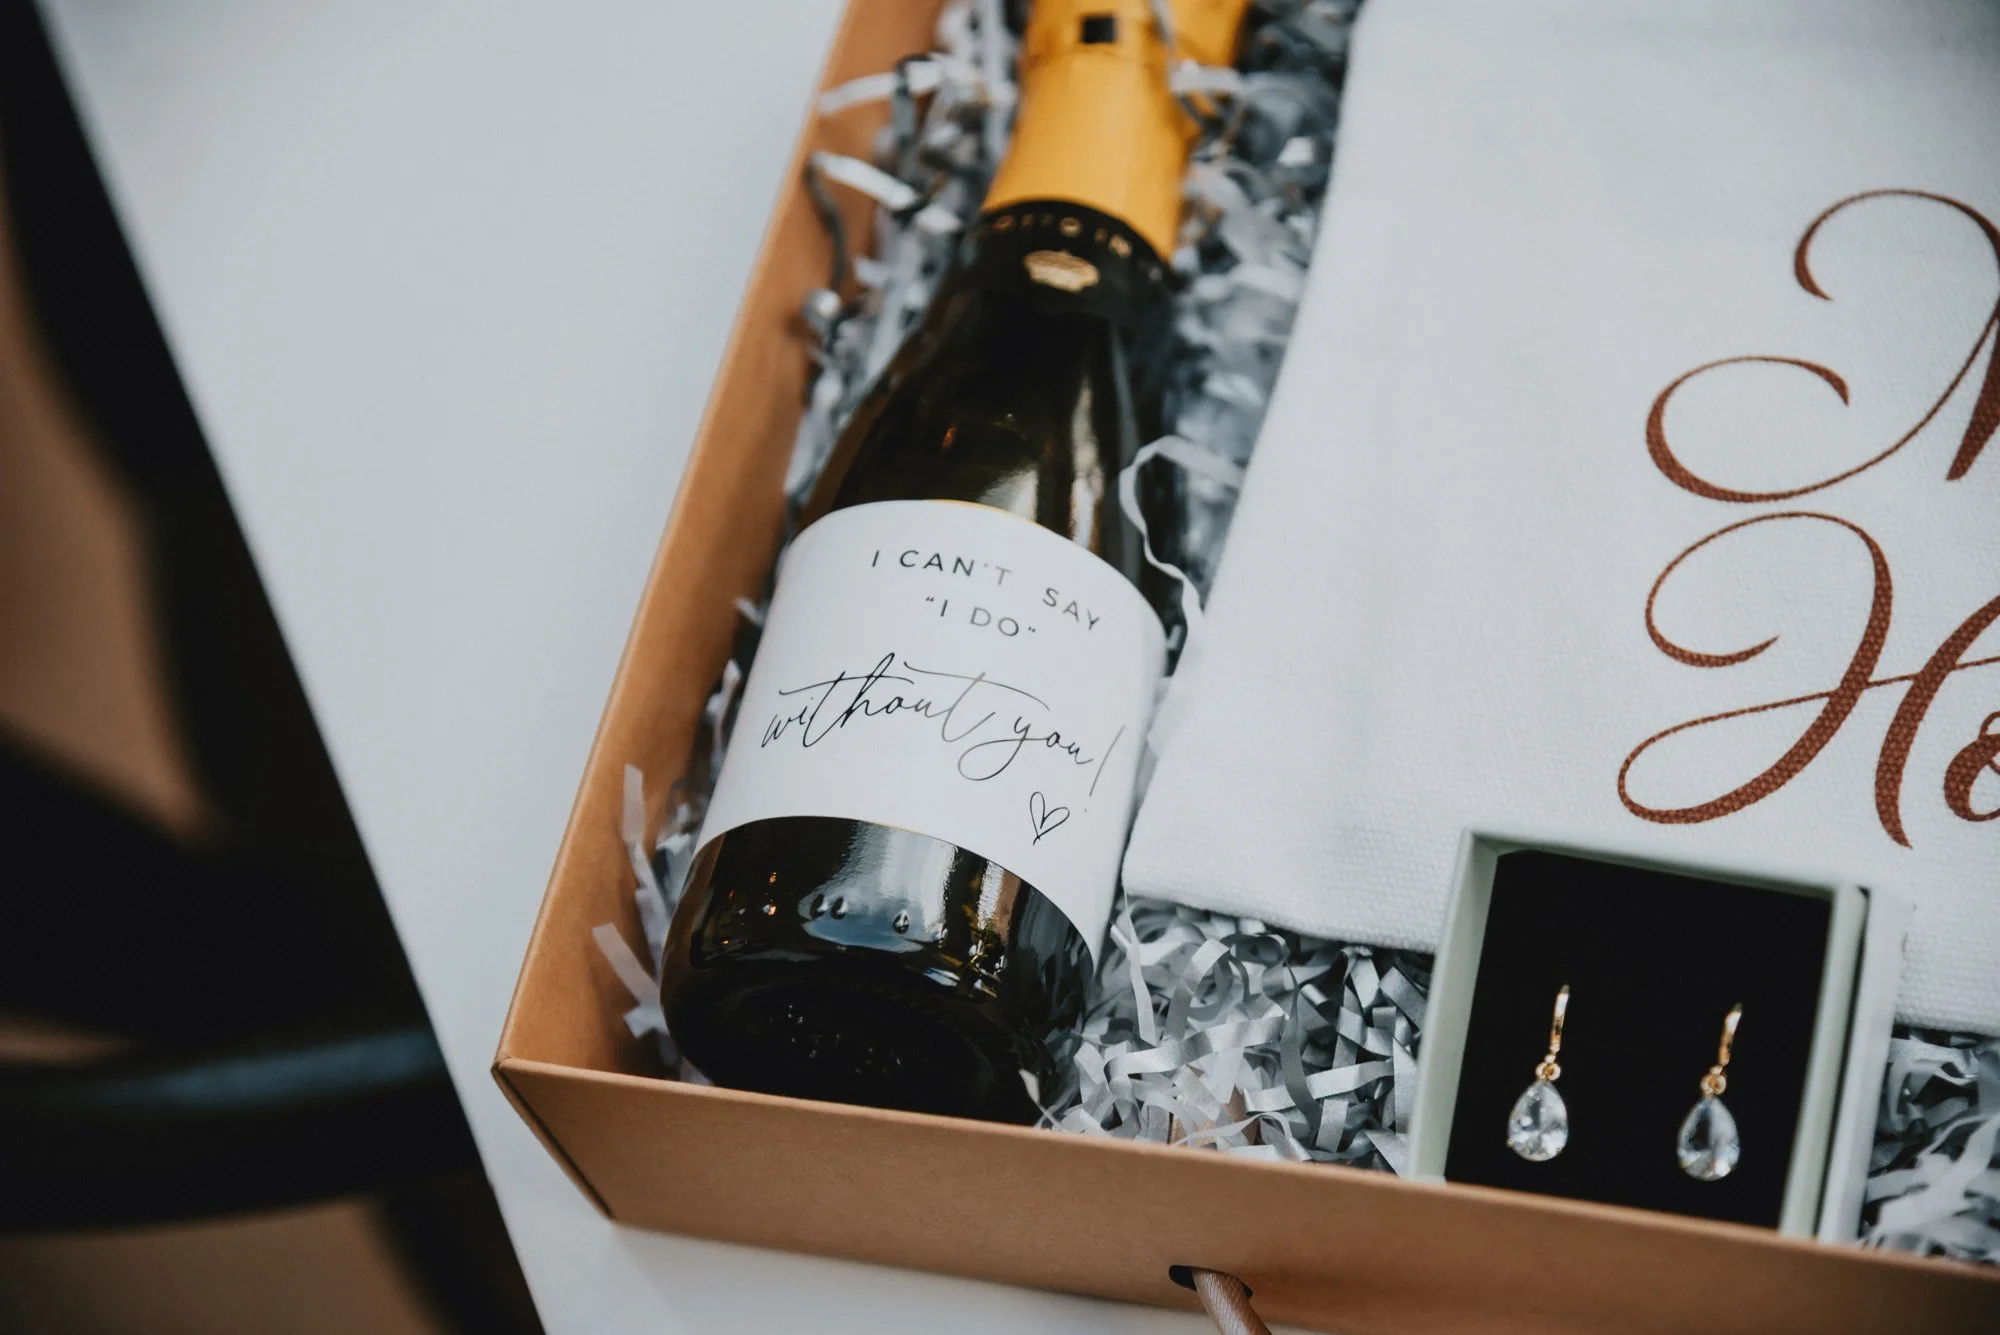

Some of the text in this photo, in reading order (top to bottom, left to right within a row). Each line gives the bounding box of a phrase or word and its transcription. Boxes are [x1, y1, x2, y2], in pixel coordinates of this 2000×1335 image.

[871, 549, 1101, 632] I CAN'T SAY
[760, 651, 1126, 815] without you!
